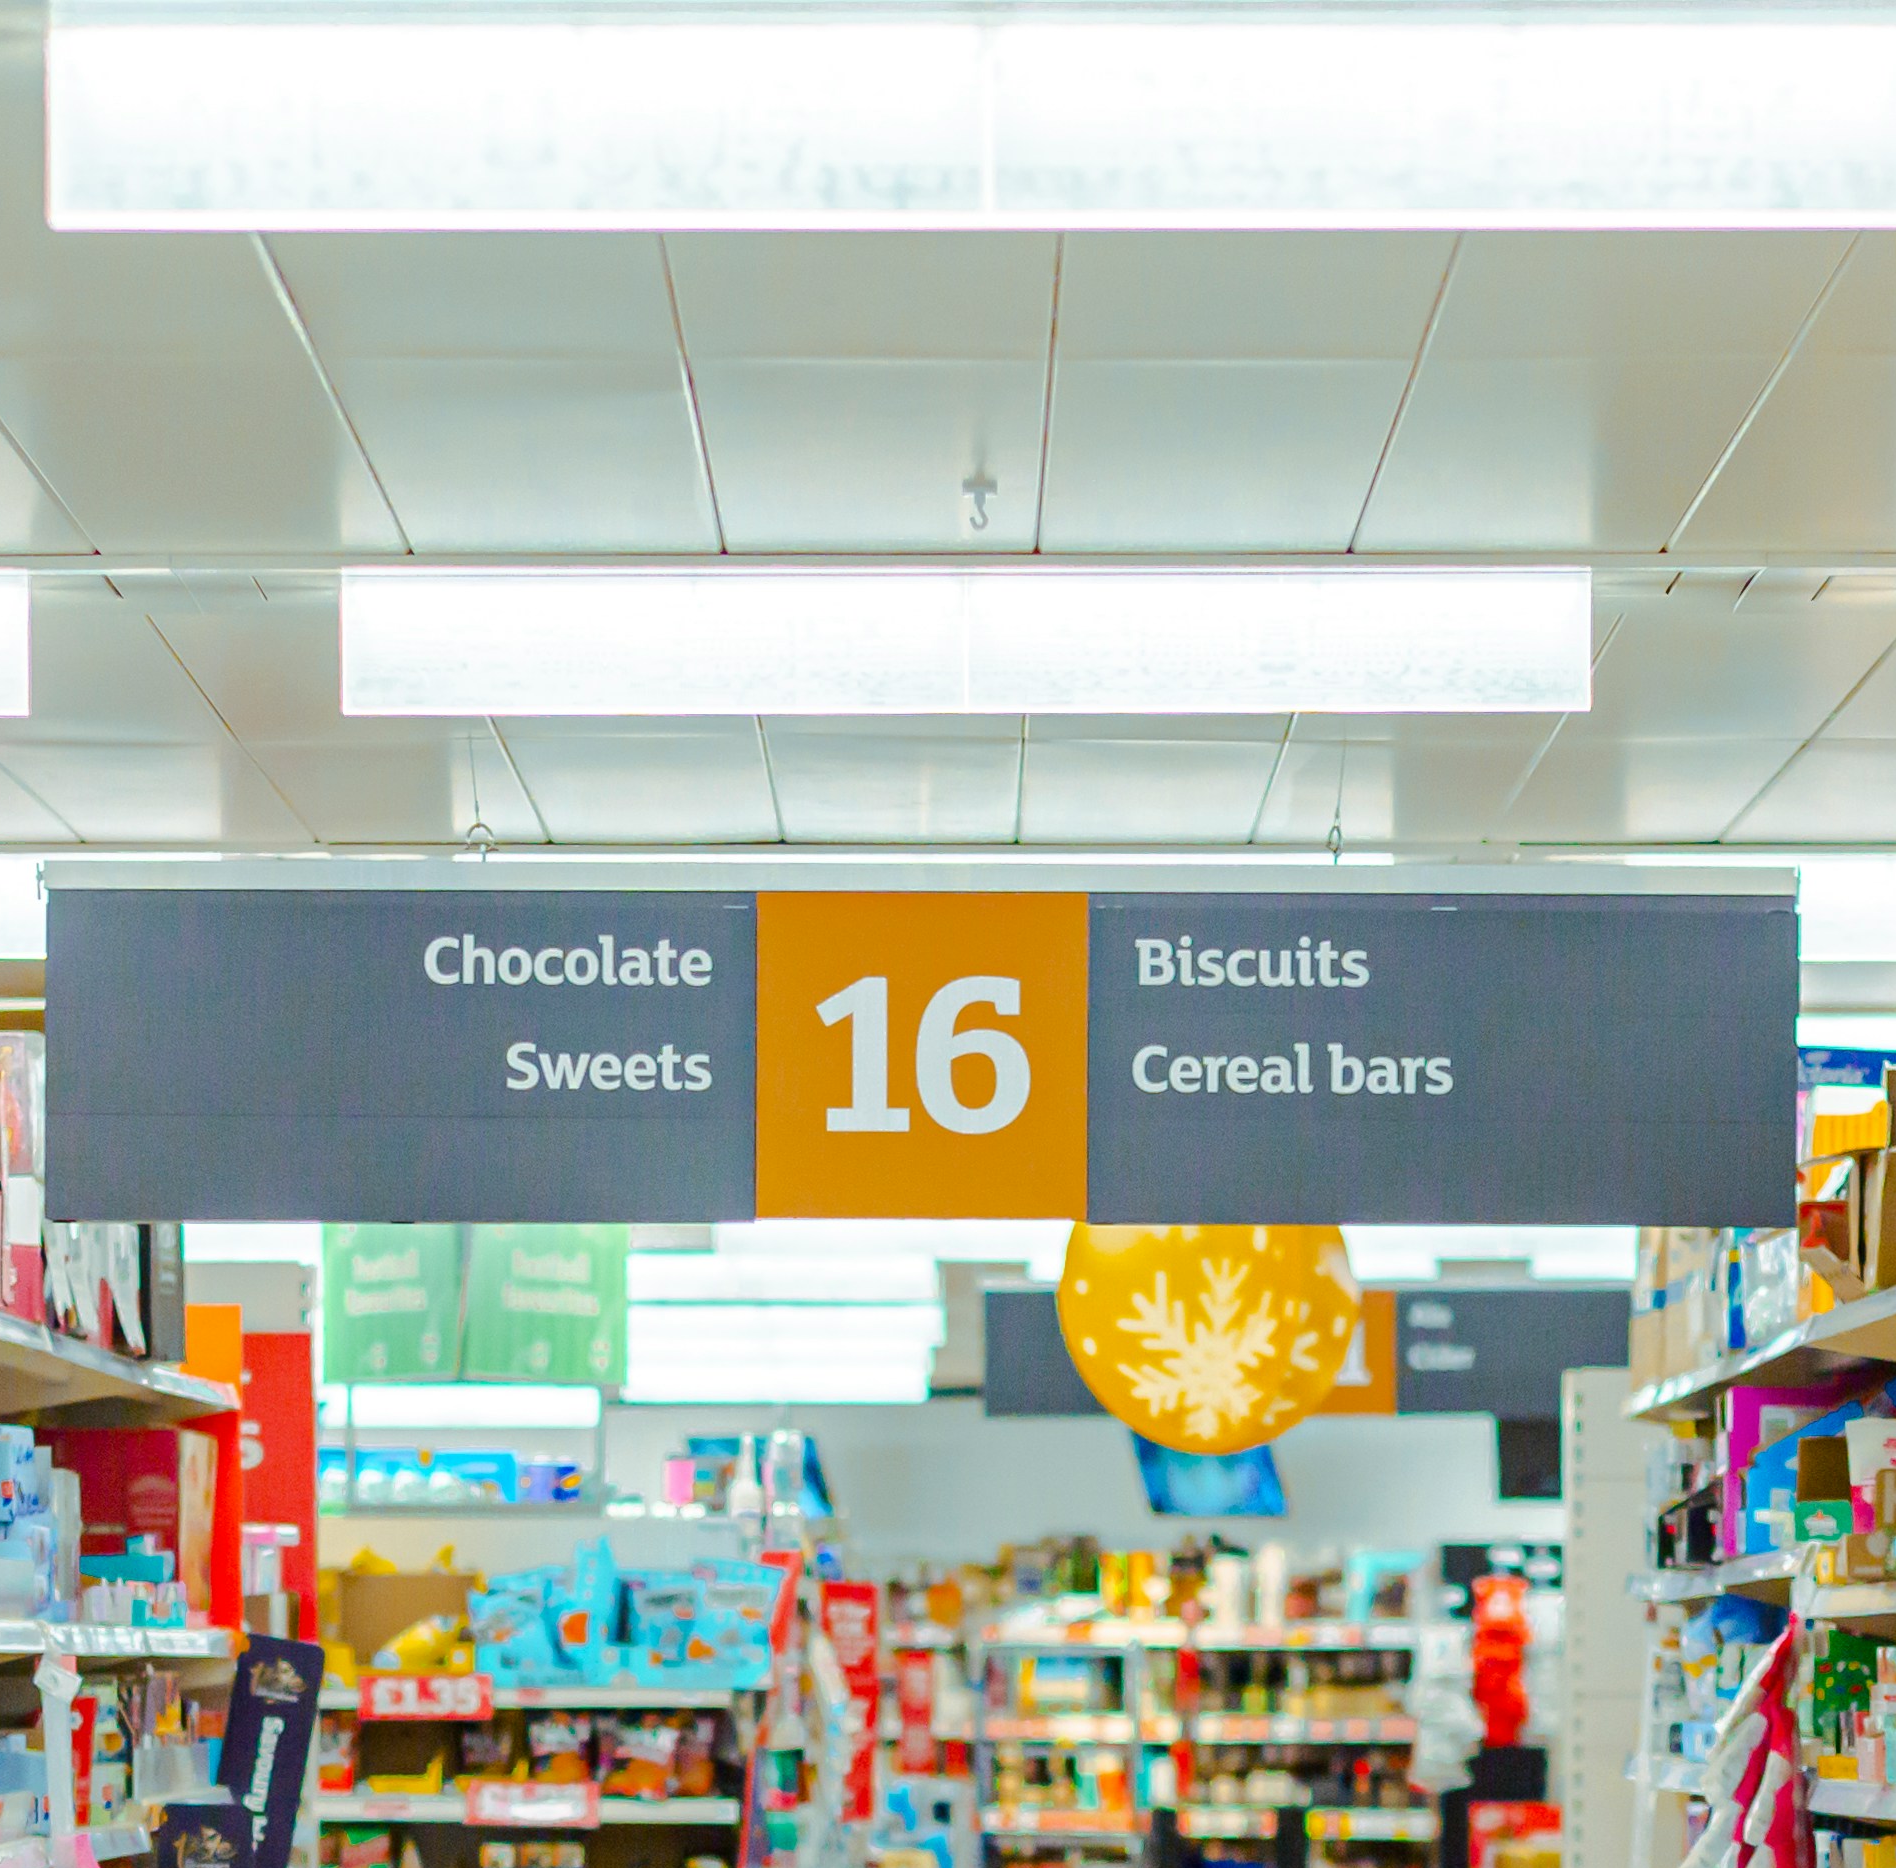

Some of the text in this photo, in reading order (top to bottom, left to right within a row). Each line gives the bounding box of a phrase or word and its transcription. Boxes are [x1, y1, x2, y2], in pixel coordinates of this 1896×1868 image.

[423, 933, 714, 987] Chocolate
[1134, 935, 1371, 988] Biscuits
[505, 1041, 714, 1092] Sweets
[815, 975, 1031, 1135] 16
[1132, 1042, 1455, 1096] Cereal bars
